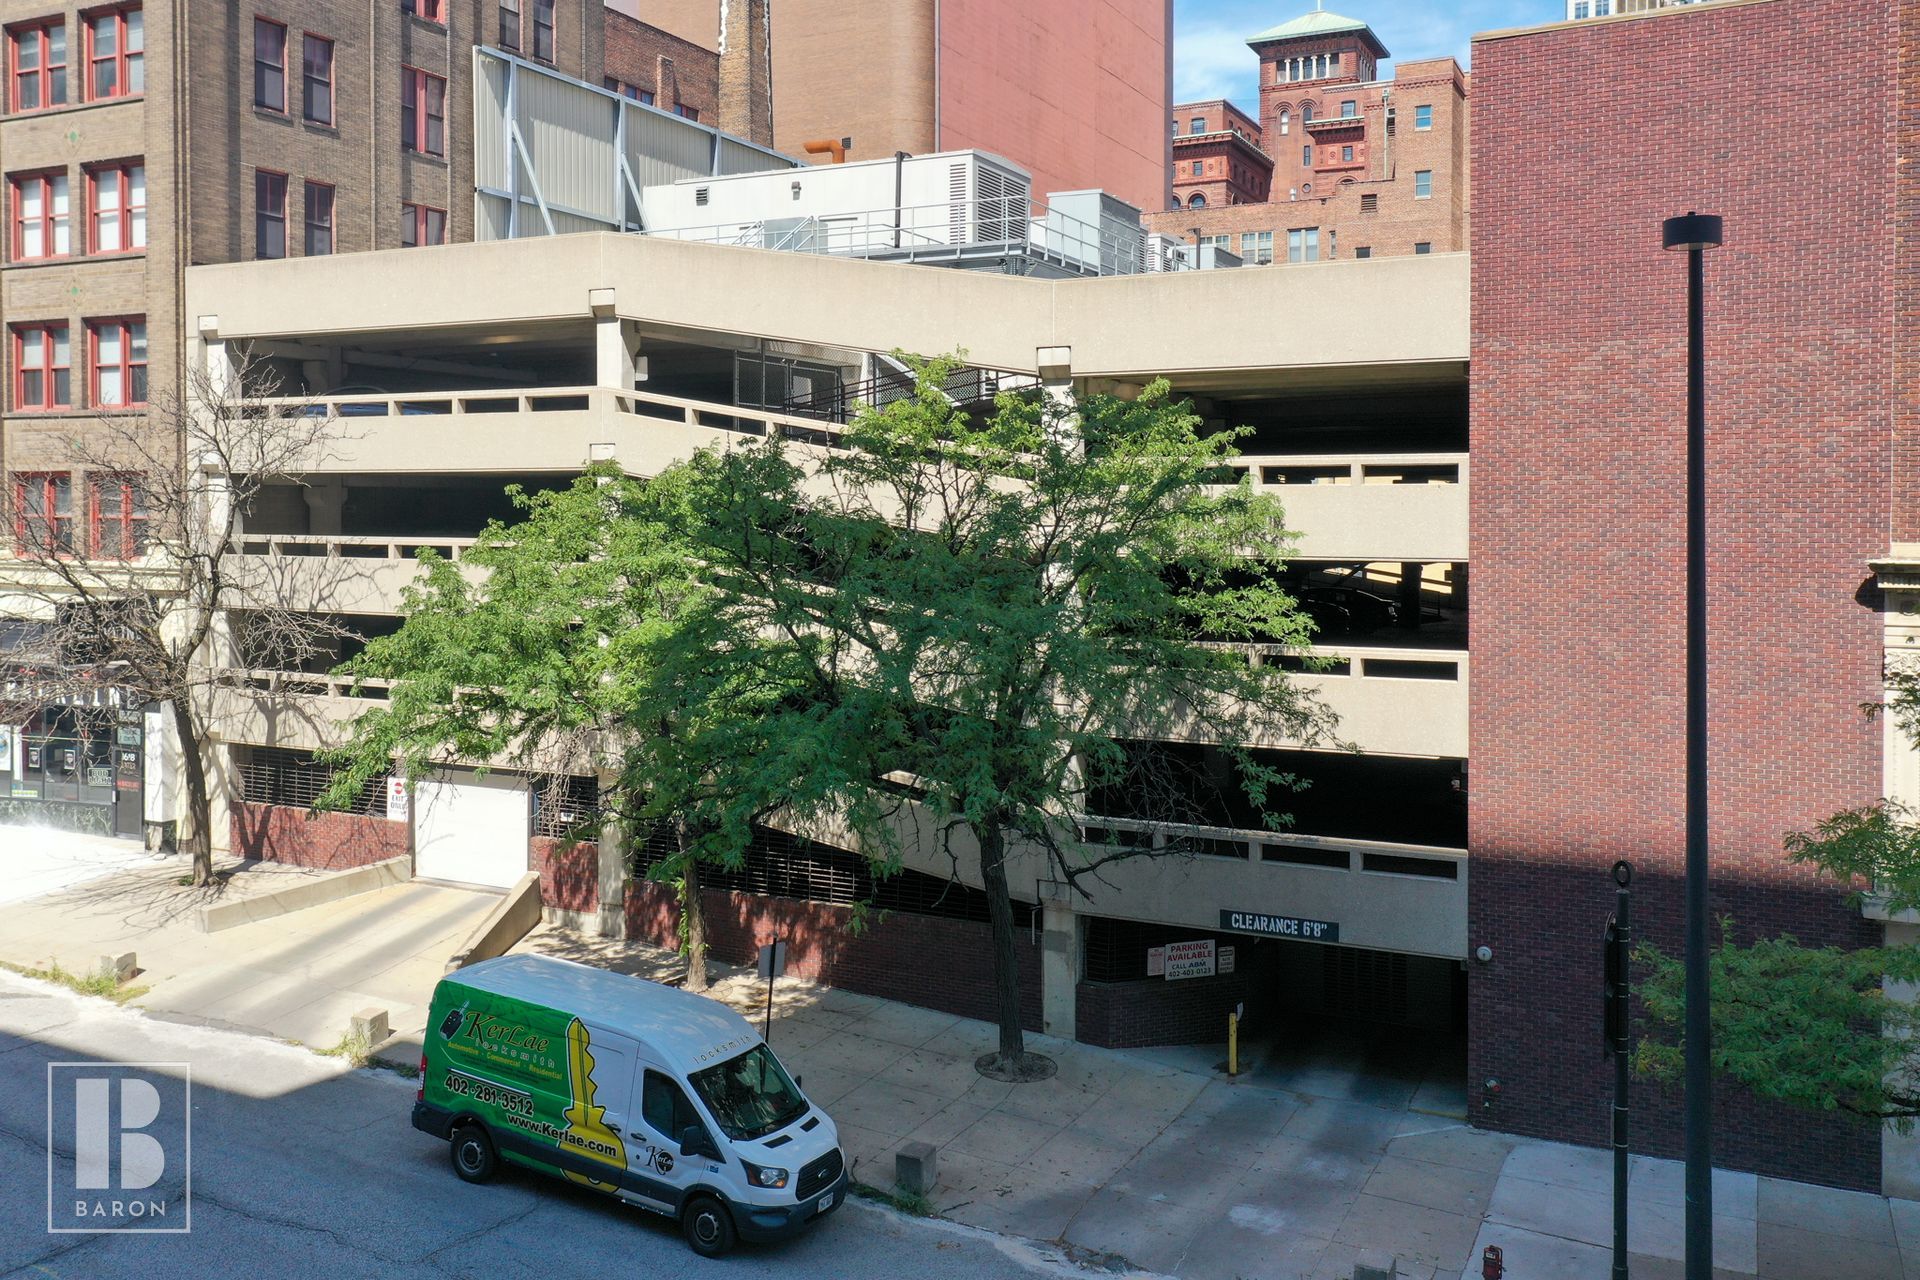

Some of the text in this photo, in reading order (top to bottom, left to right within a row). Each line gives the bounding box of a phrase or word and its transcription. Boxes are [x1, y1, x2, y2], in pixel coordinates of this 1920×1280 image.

[1231, 913, 1328, 937] CLEARANCE 6'8"
[1167, 950, 1212, 962] AVAILABLE
[1170, 942, 1208, 953] PARKING
[1171, 960, 1207, 970] CALL ABM
[464, 1011, 550, 1052] KerLae
[447, 1041, 480, 1055] Automotive
[486, 1052, 521, 1067] Commercial
[528, 1063, 563, 1080] Residential
[475, 1038, 555, 1069] locksmith
[692, 1035, 751, 1064] locksmith
[507, 1114, 617, 1158] www.Kerlae.com
